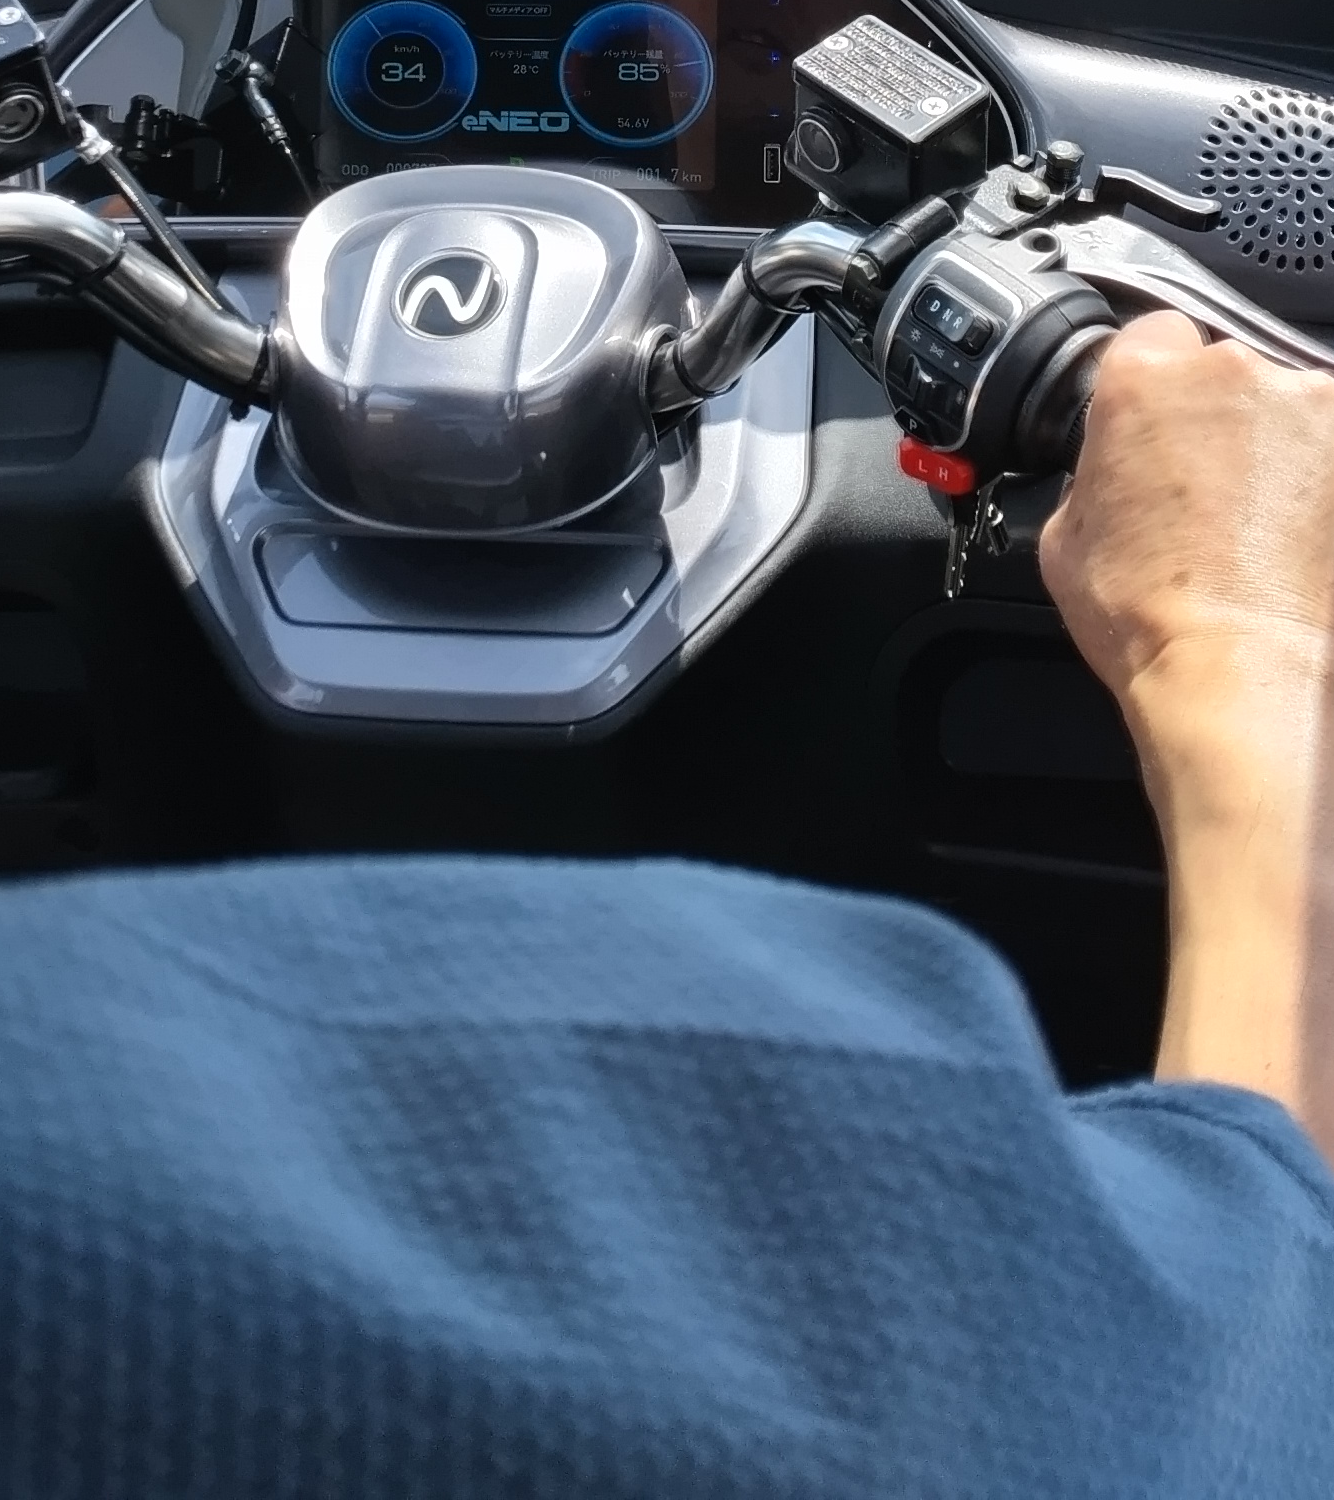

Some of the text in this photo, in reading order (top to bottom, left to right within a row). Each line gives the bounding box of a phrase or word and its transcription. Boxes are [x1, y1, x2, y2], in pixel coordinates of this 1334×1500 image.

[394, 44, 420, 53] km/h
[381, 62, 427, 82] 34
[462, 110, 570, 133] eNEO
[617, 117, 650, 128] 54.6V
[341, 164, 370, 176] ODO
[591, 169, 621, 181] TRIP
[682, 171, 702, 183] km
[929, 300, 963, 329] D N R
[909, 418, 918, 431] P
[918, 458, 949, 481] L H
